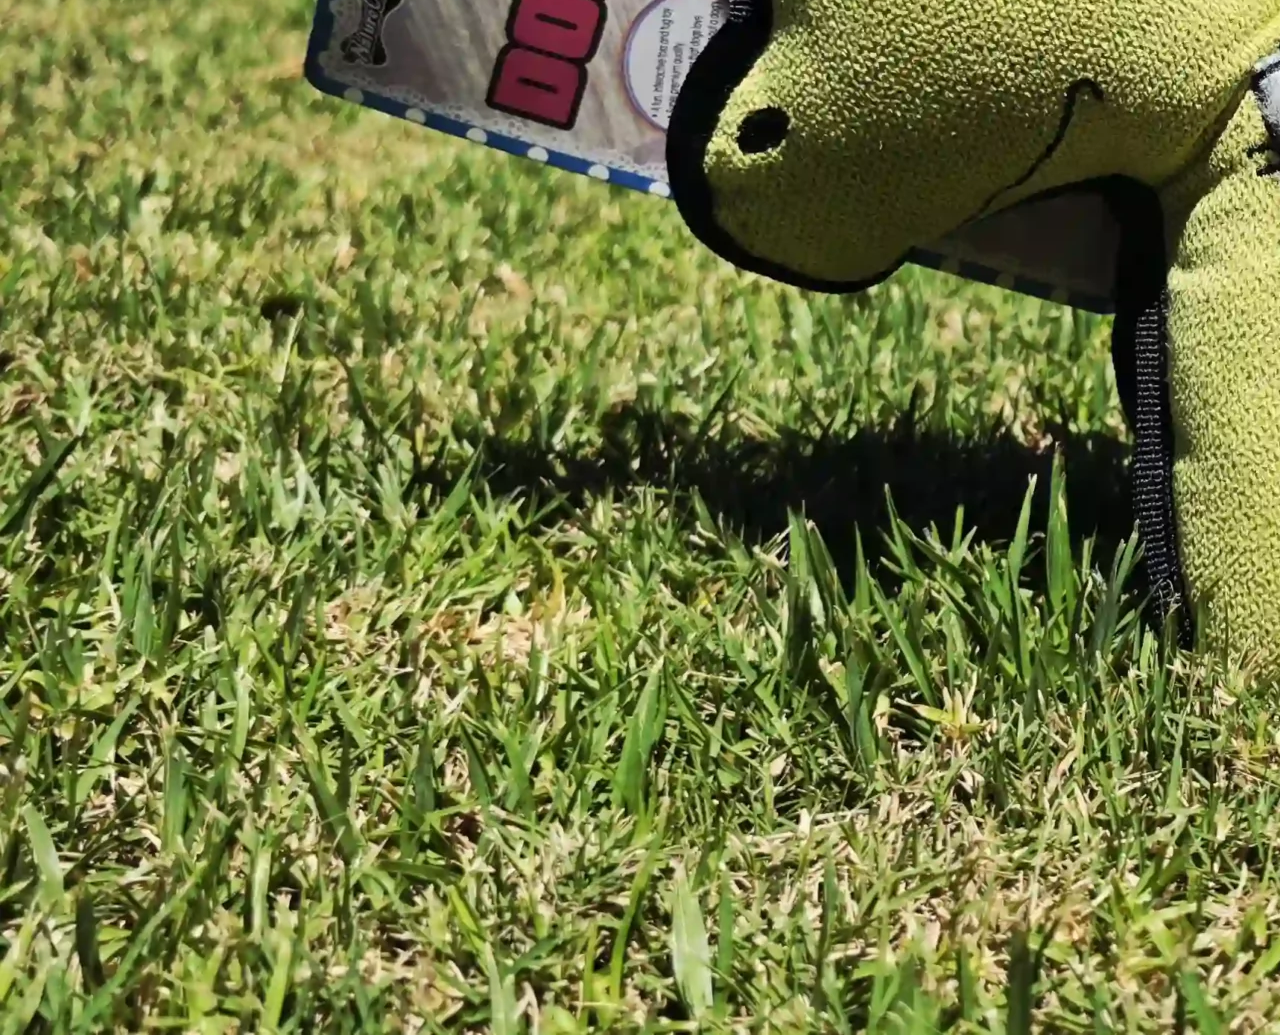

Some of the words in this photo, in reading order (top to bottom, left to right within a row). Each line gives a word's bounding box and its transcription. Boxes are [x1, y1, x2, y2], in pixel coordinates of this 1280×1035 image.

[662, 8, 673, 18] toy
[659, 19, 673, 30] tug
[689, 15, 703, 29] love
[659, 31, 670, 45] and
[690, 30, 704, 46] dogs
[673, 43, 686, 64] quality
[669, 65, 683, 94] premium
